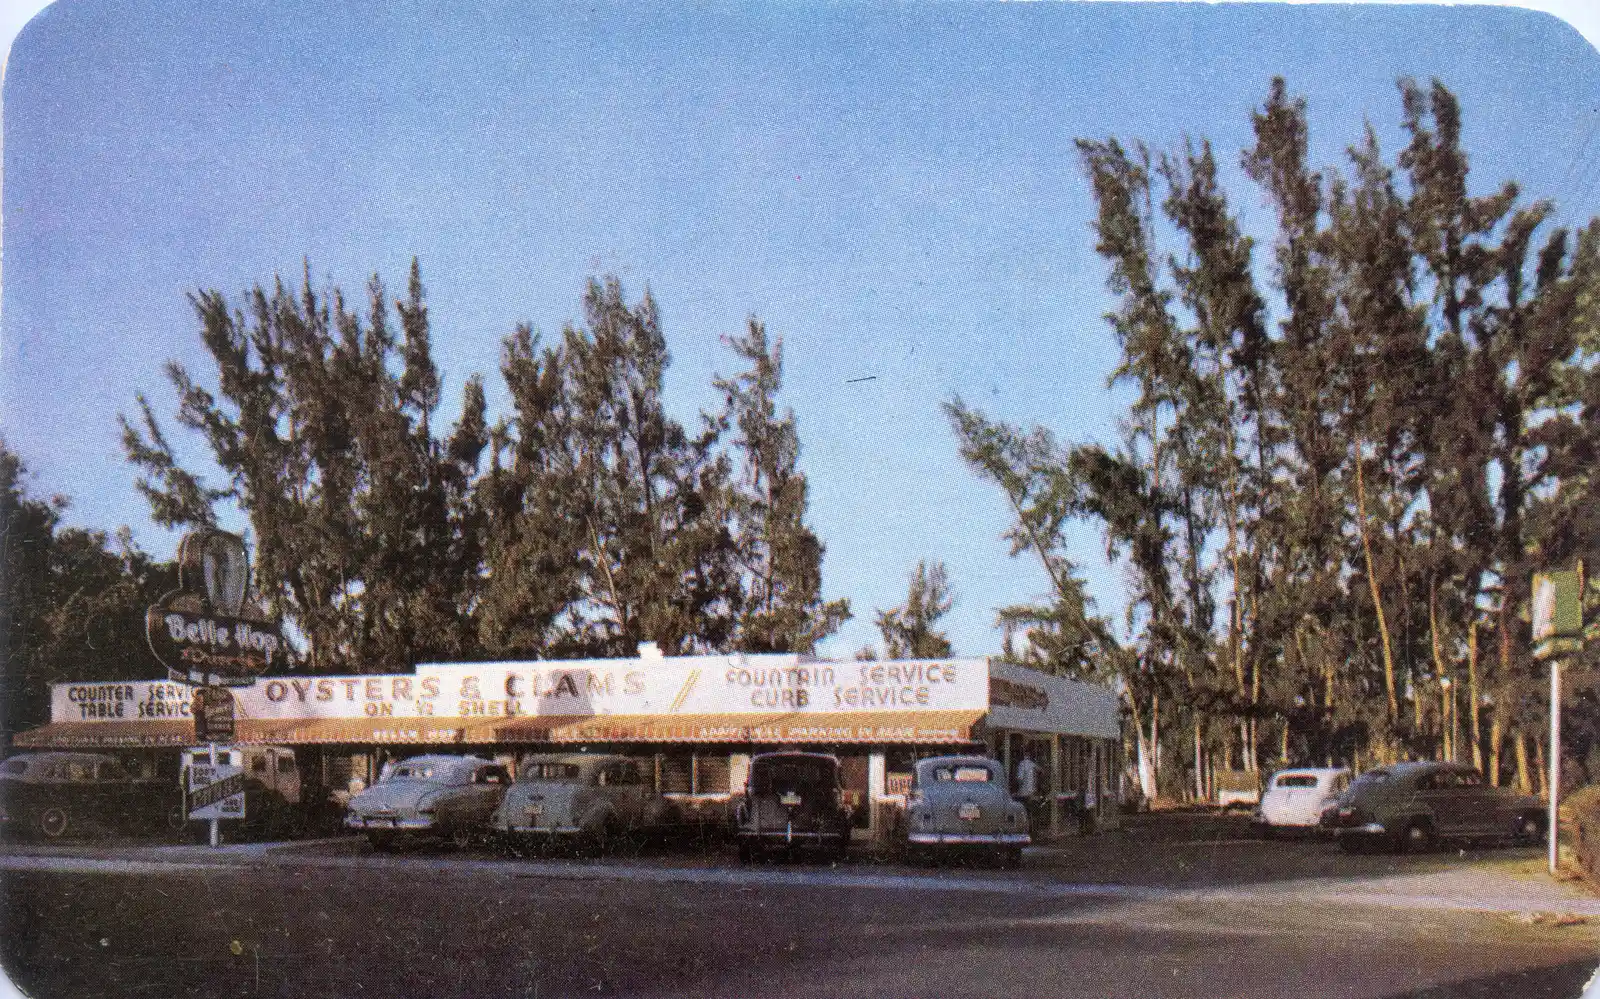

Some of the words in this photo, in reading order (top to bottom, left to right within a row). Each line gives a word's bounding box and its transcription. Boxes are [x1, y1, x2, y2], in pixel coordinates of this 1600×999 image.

[165, 614, 230, 648] Belle
[234, 623, 278, 664] Hop
[265, 676, 441, 702] OYSTERS
[459, 675, 481, 700] &
[504, 669, 647, 698] CLAMS
[726, 666, 834, 687] FOUNTAIN
[859, 663, 957, 685] SERVICE
[68, 685, 133, 702] COUNTER
[148, 683, 192, 700] SERVI
[751, 688, 809, 708] CURB
[833, 685, 930, 707] SERVICE
[80, 702, 124, 720] TABLE
[138, 701, 190, 718] SERVIC
[364, 701, 393, 716] ON
[458, 699, 526, 716] SHELL
